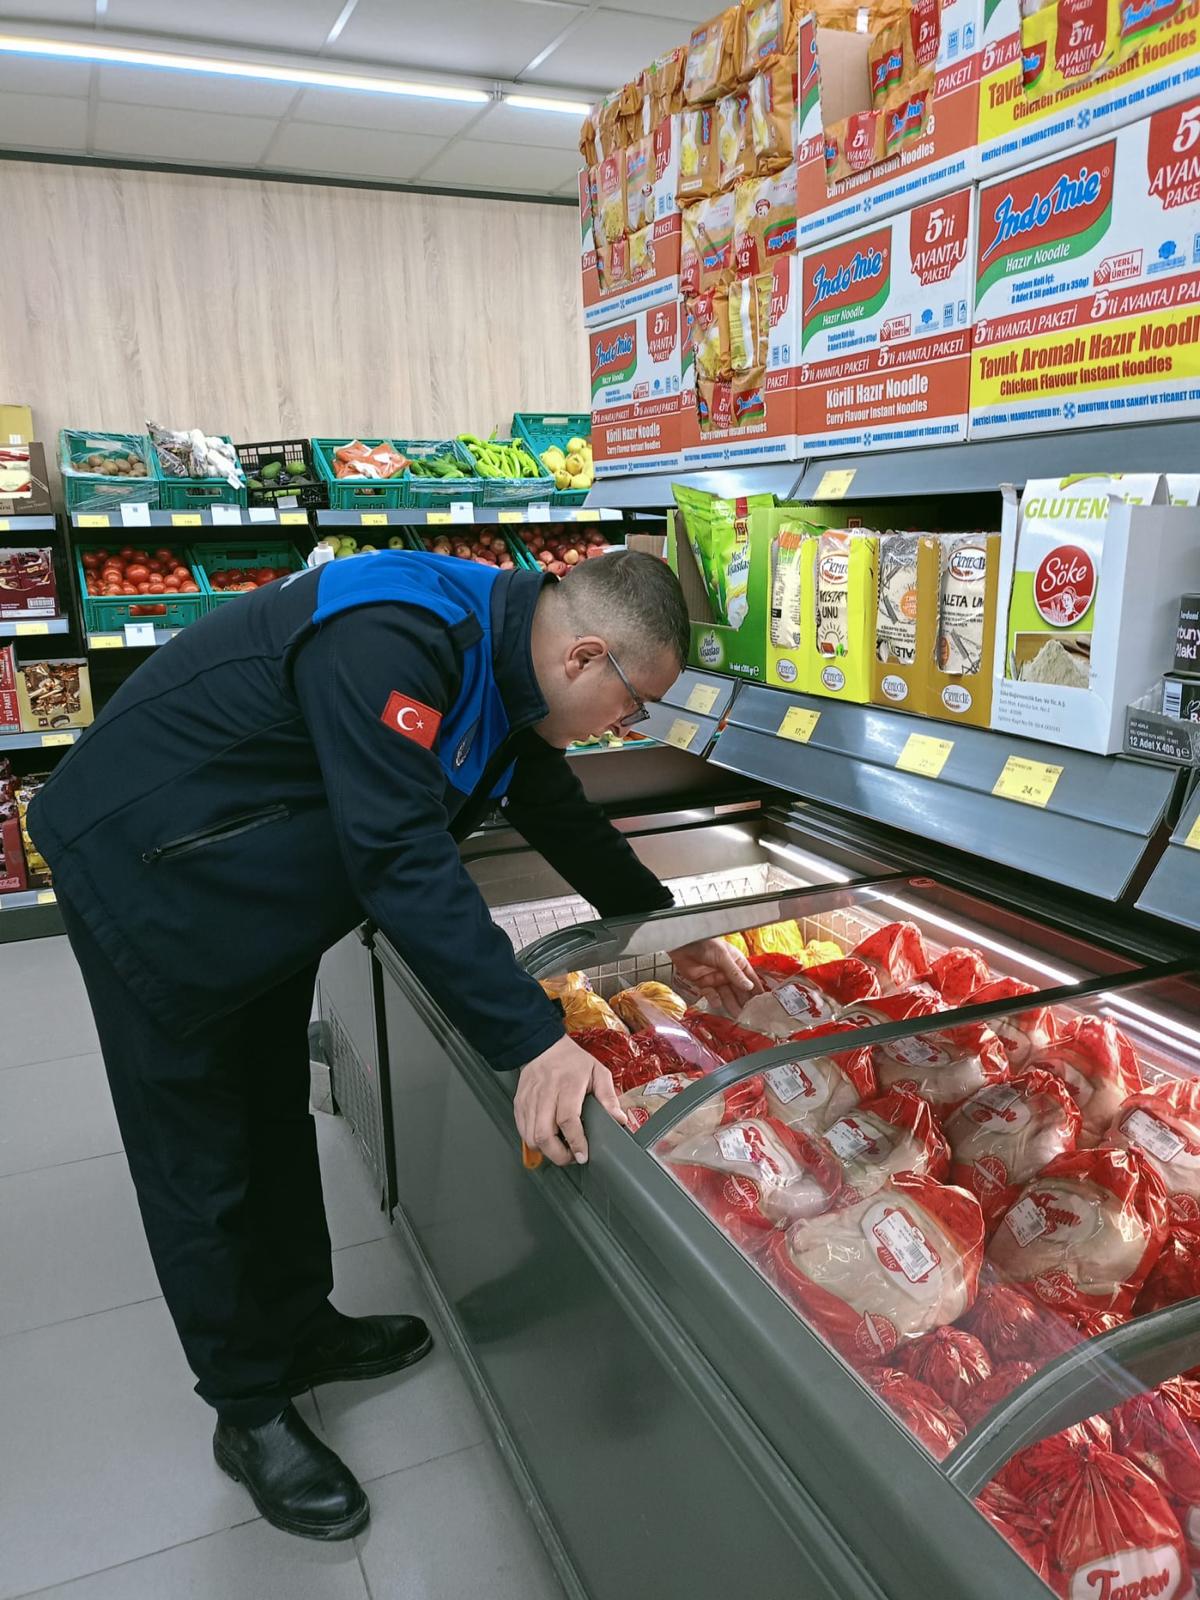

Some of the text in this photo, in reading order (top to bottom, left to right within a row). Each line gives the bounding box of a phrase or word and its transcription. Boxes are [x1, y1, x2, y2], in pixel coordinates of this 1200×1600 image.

[1069, 20, 1094, 47] 5'li
[1056, 40, 1105, 70] AVANTAJ
[938, 63, 972, 95] PAKETİ
[1064, 62, 1091, 78] PAKETİ
[901, 142, 935, 167] Noodles
[1150, 155, 1200, 194] AVAN
[1164, 186, 1200, 209] PAKE
[924, 208, 955, 243] 5'li
[911, 238, 967, 274] AVANTAJ
[1005, 243, 1070, 273] Hazır Noodle
[1112, 255, 1134, 269] YERLİ
[920, 264, 952, 287] PAKETİ
[1110, 264, 1139, 279] ÜRETİM
[840, 305, 864, 321] Noodle
[1090, 290, 1117, 319] 5'li
[1118, 284, 1175, 314] AVANTAJ
[974, 304, 1077, 344] 5'li AVANTAJ PAKETİ
[648, 334, 677, 354] AVANTAJ
[896, 346, 931, 364] AVANTAJ
[931, 335, 964, 356] PAKETİ
[980, 350, 1018, 380] Tavuk
[1020, 338, 1086, 373] Aromalı
[1088, 330, 1137, 361] Hazır
[766, 371, 789, 390] PAKETİ
[815, 364, 845, 381] AVANTAJ
[844, 355, 870, 376] PAKETİ
[1000, 357, 1172, 396] Chicken Flavour Instant Noodles
[826, 373, 929, 409] Körili Hazır Noodle
[1150, 395, 1160, 405] VE
[1160, 391, 1188, 405] TİCARET
[661, 398, 679, 412] PAKETİ
[826, 400, 928, 426] Curry Flavour Instant Noodles
[637, 421, 661, 438] Noodle
[1024, 496, 1113, 520] GLUTEN
[1041, 555, 1088, 593] Söke
[822, 606, 839, 619] UNU
[943, 594, 968, 609] ALETA
[1129, 736, 1138, 746] 12
[1139, 737, 1155, 750] Adet
[1155, 741, 1161, 751] X
[1162, 742, 1174, 755] 400
